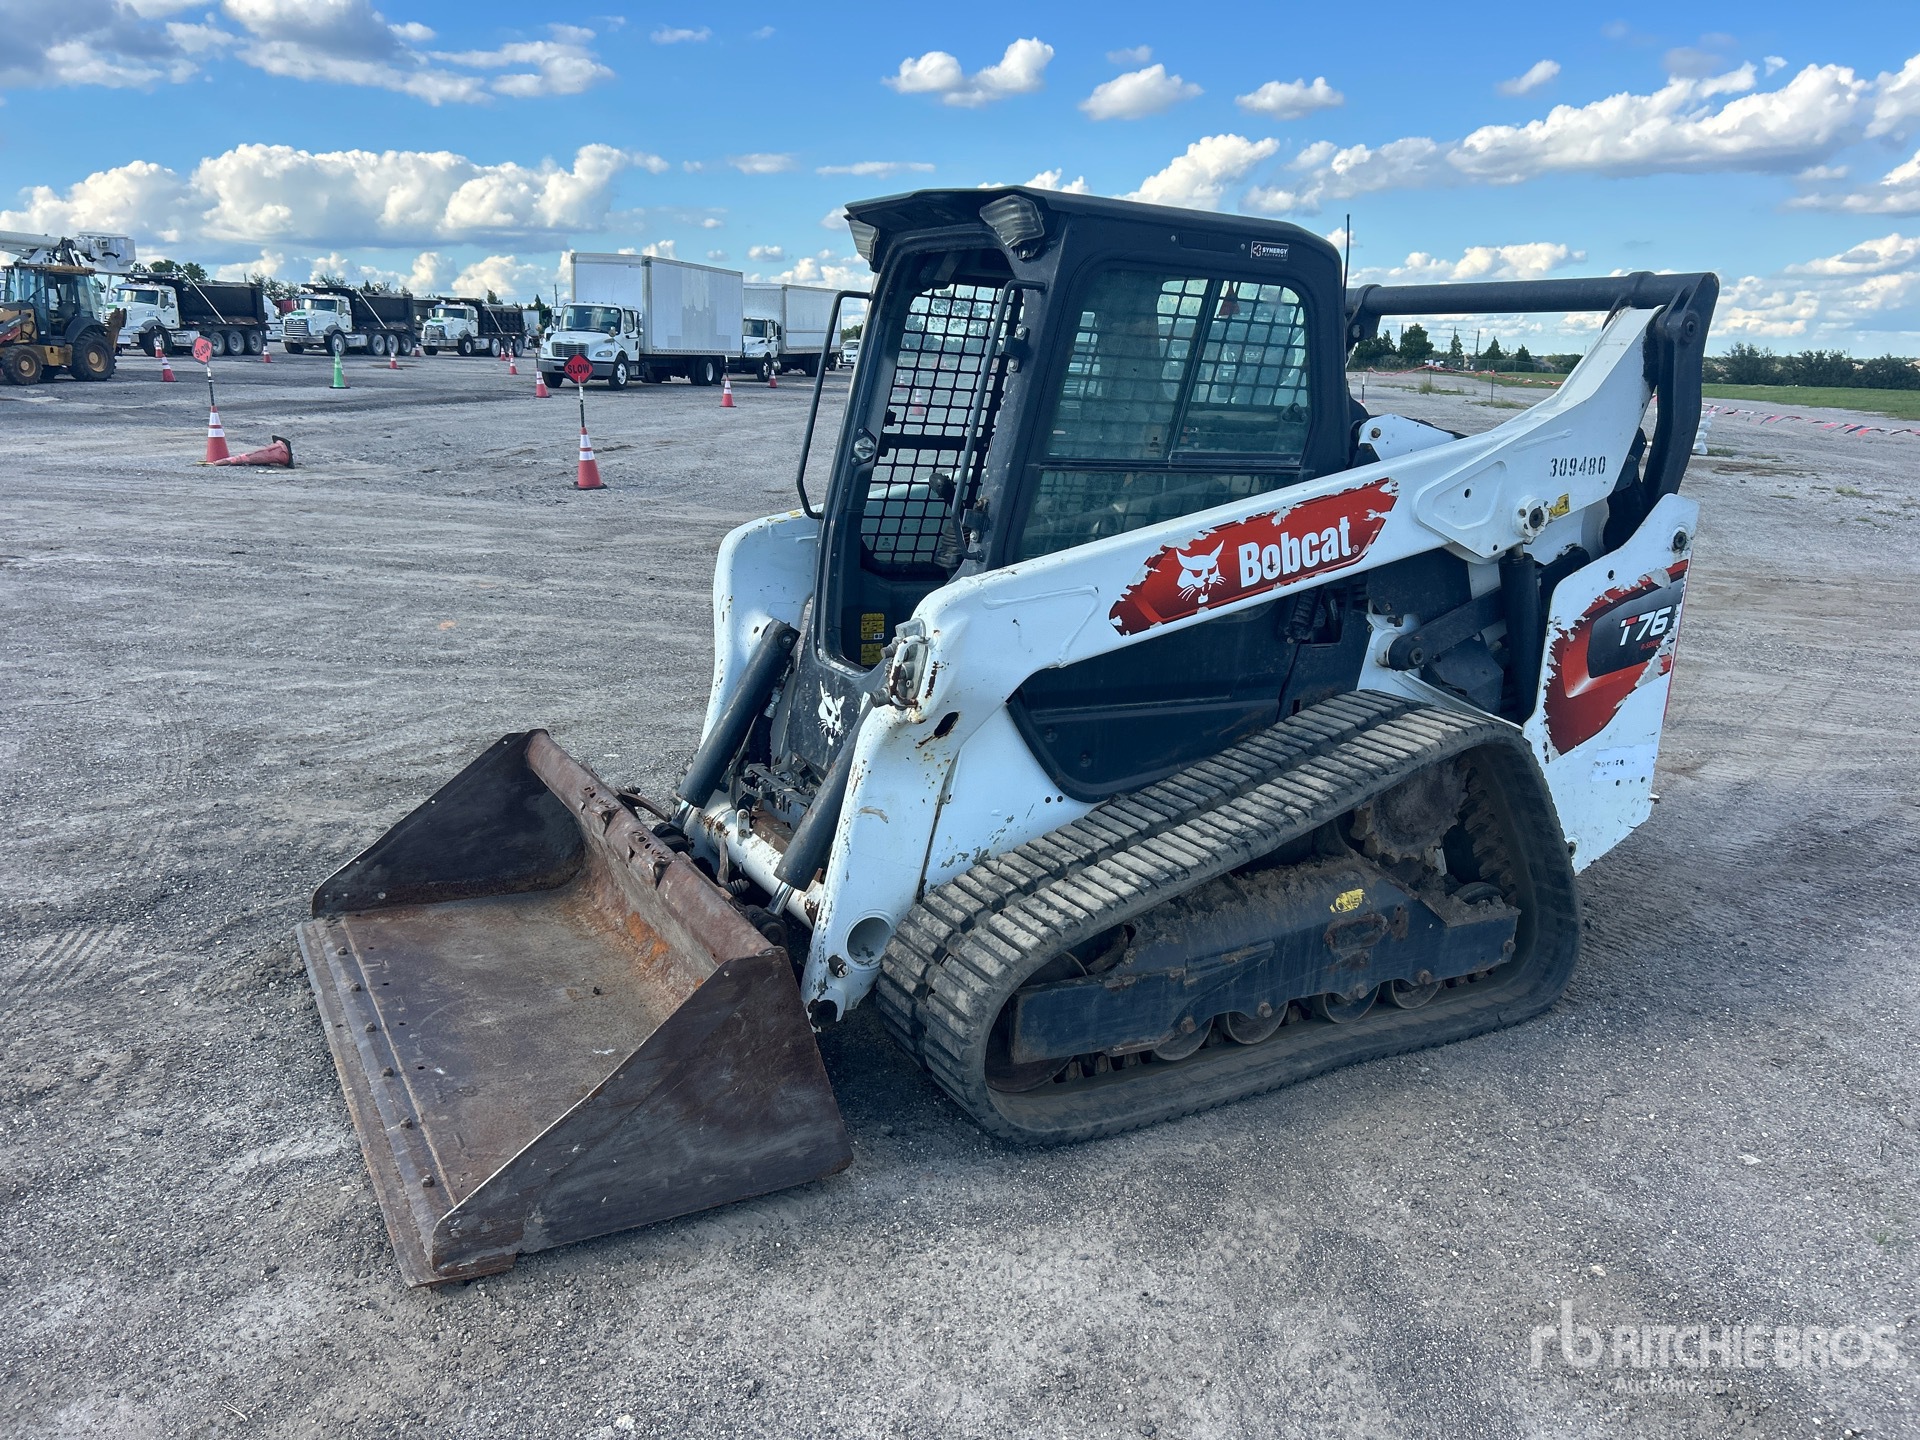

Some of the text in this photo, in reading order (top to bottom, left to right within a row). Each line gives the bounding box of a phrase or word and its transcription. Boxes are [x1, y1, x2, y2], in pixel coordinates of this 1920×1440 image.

[195, 343, 210, 358] SLOW
[567, 364, 590, 374] SLOW
[1549, 455, 1606, 477] 309480
[1238, 516, 1352, 588] Bobcat
[1619, 606, 1673, 646] T76
